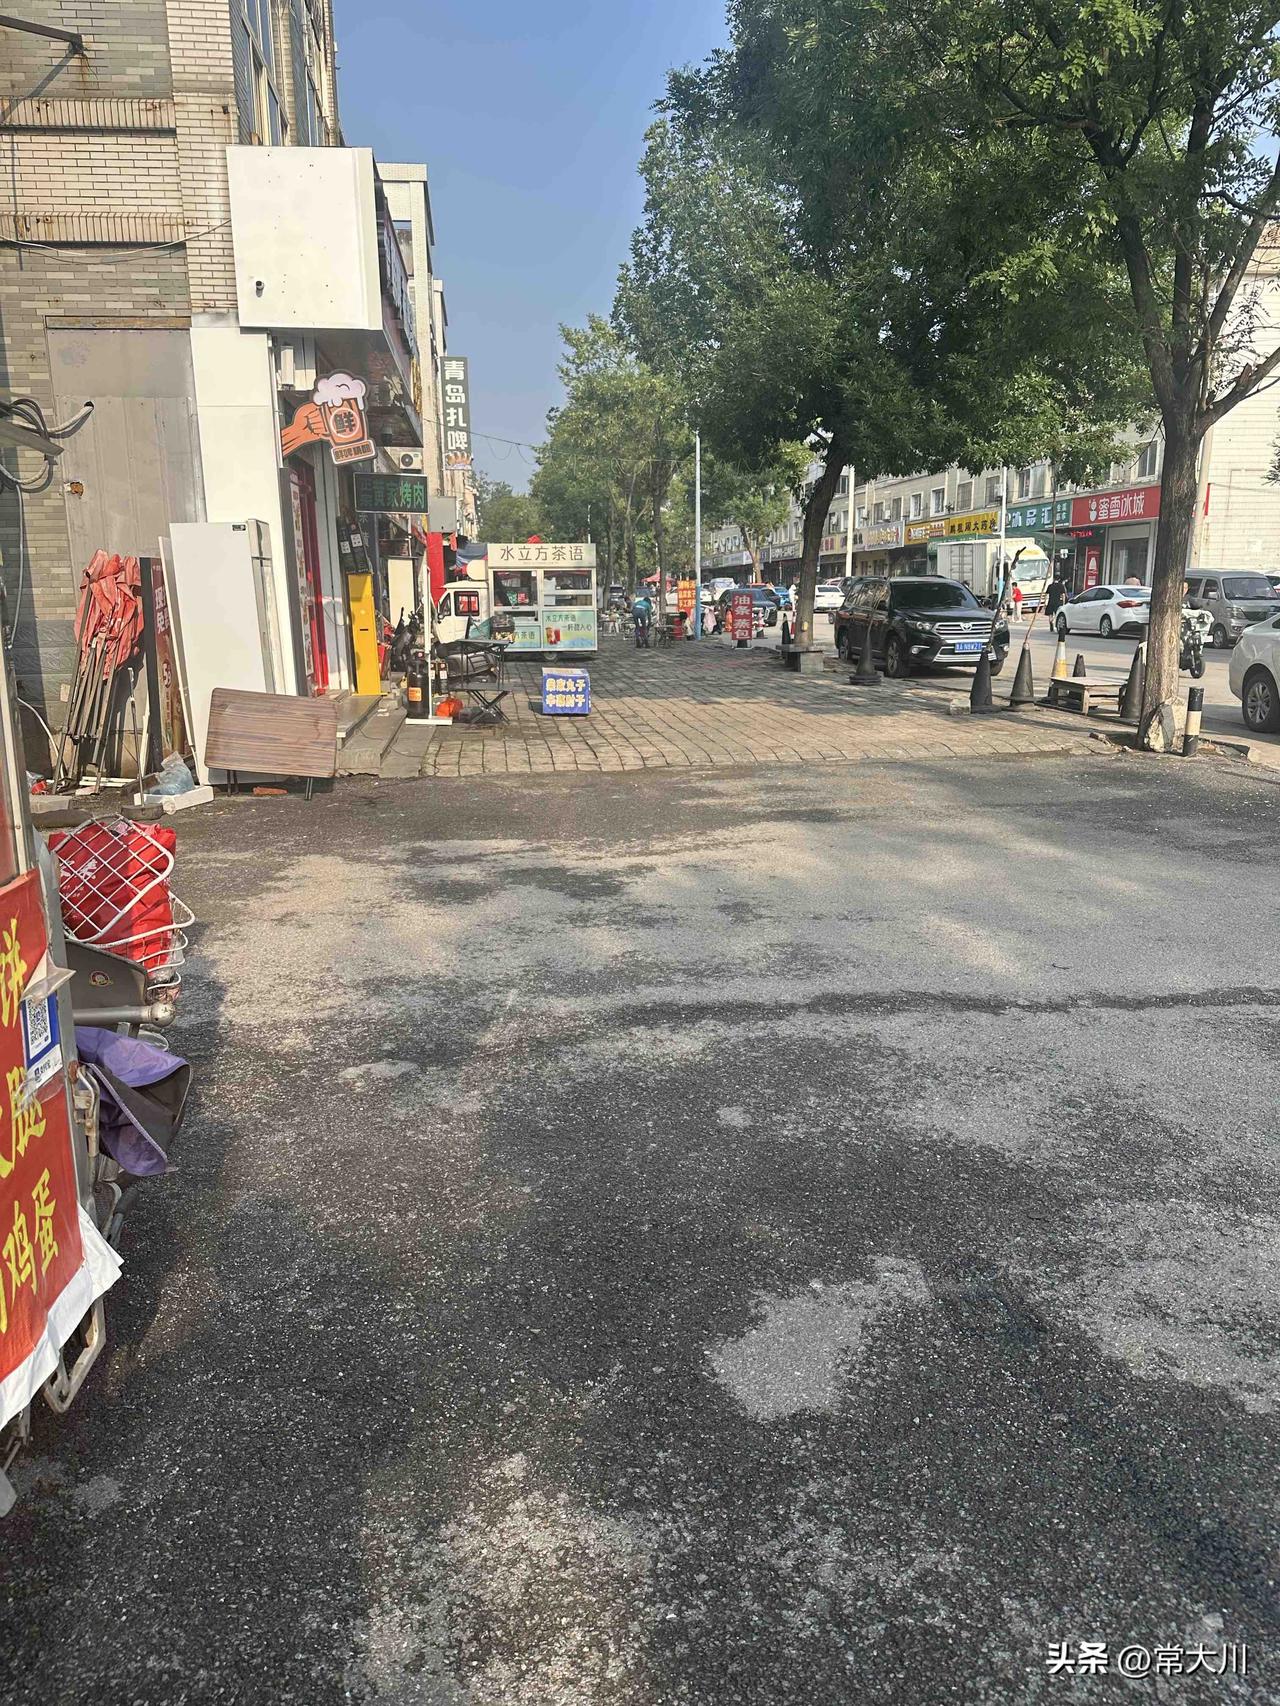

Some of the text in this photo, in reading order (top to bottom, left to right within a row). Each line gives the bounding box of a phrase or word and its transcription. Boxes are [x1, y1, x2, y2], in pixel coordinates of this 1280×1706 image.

[444, 360, 468, 450] 青岛扎啤
[1098, 490, 1145, 520] 蜜雪冰城
[500, 545, 584, 561] 水立方茶语
[734, 595, 750, 639] 油条蒸包
